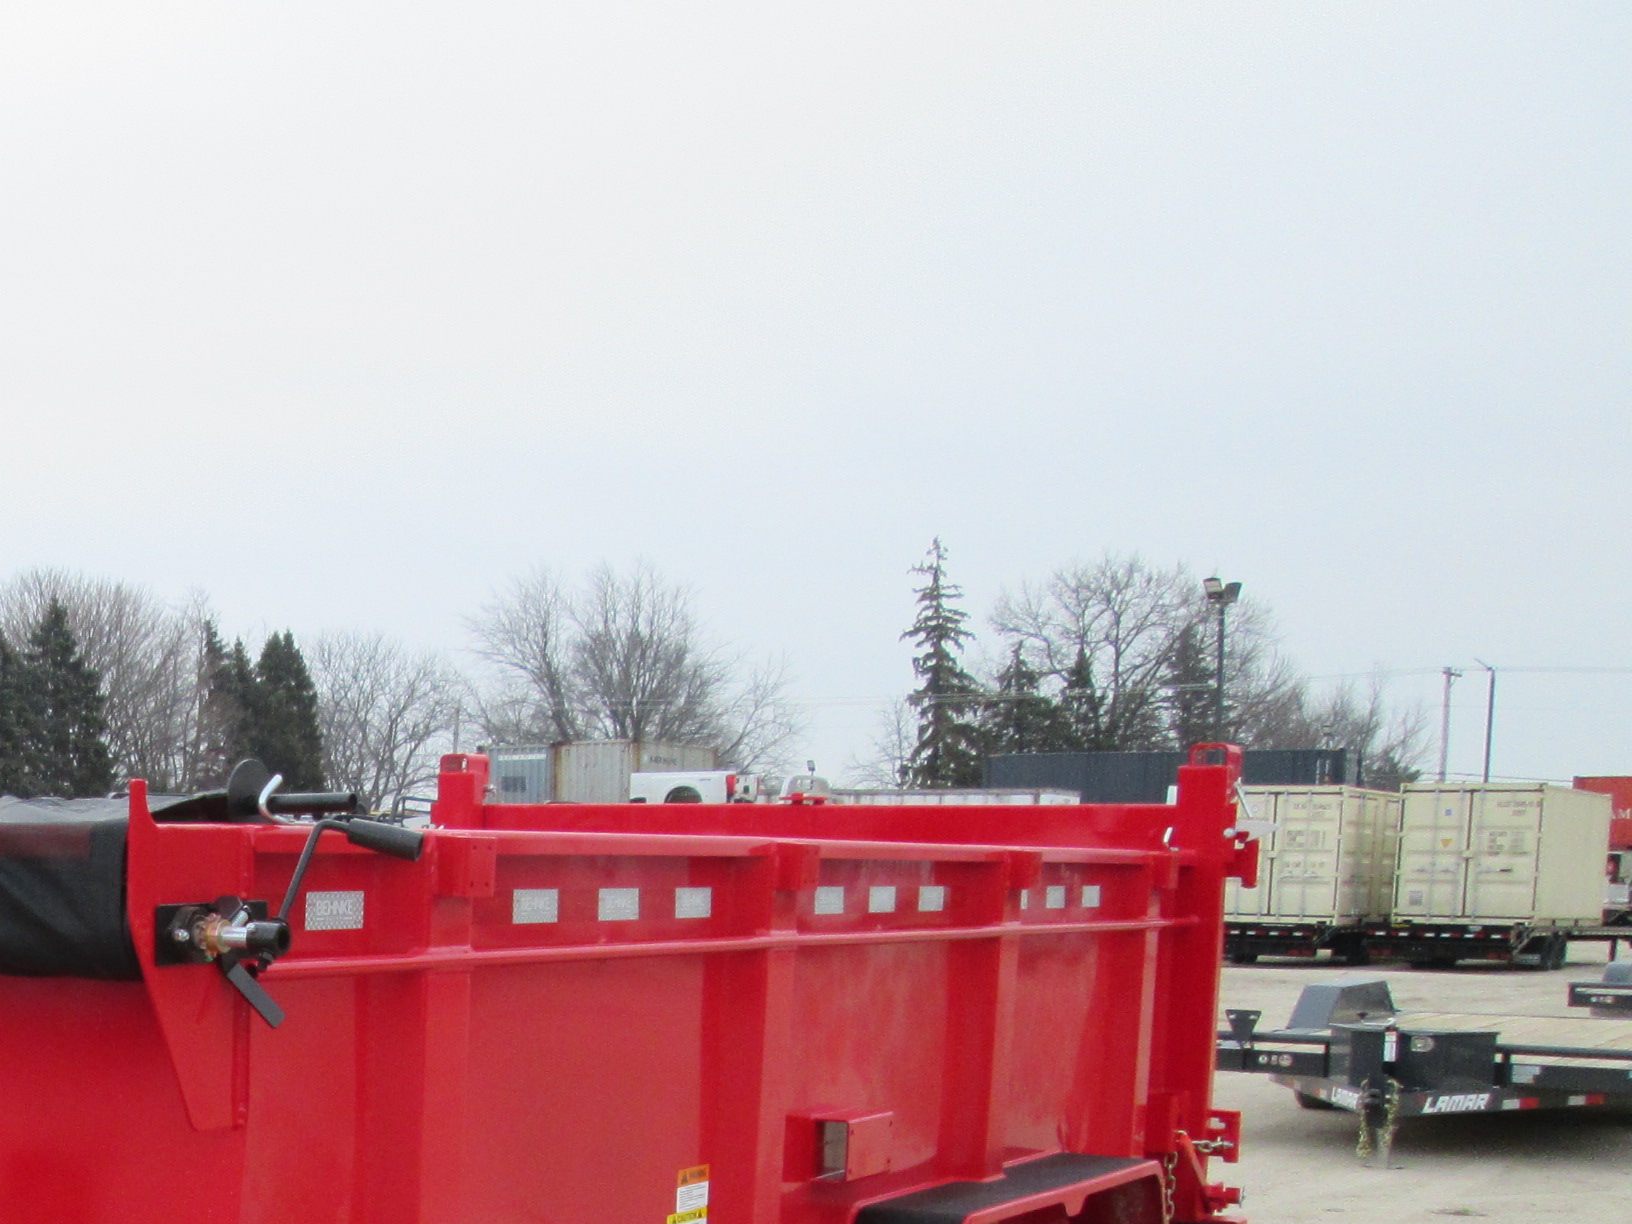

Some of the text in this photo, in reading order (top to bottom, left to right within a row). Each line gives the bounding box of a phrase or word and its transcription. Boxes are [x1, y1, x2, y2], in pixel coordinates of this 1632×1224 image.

[316, 899, 354, 916] BEHNKE
[1422, 1093, 1490, 1114] LAMAR
[676, 1212, 696, 1224] CAUTION
